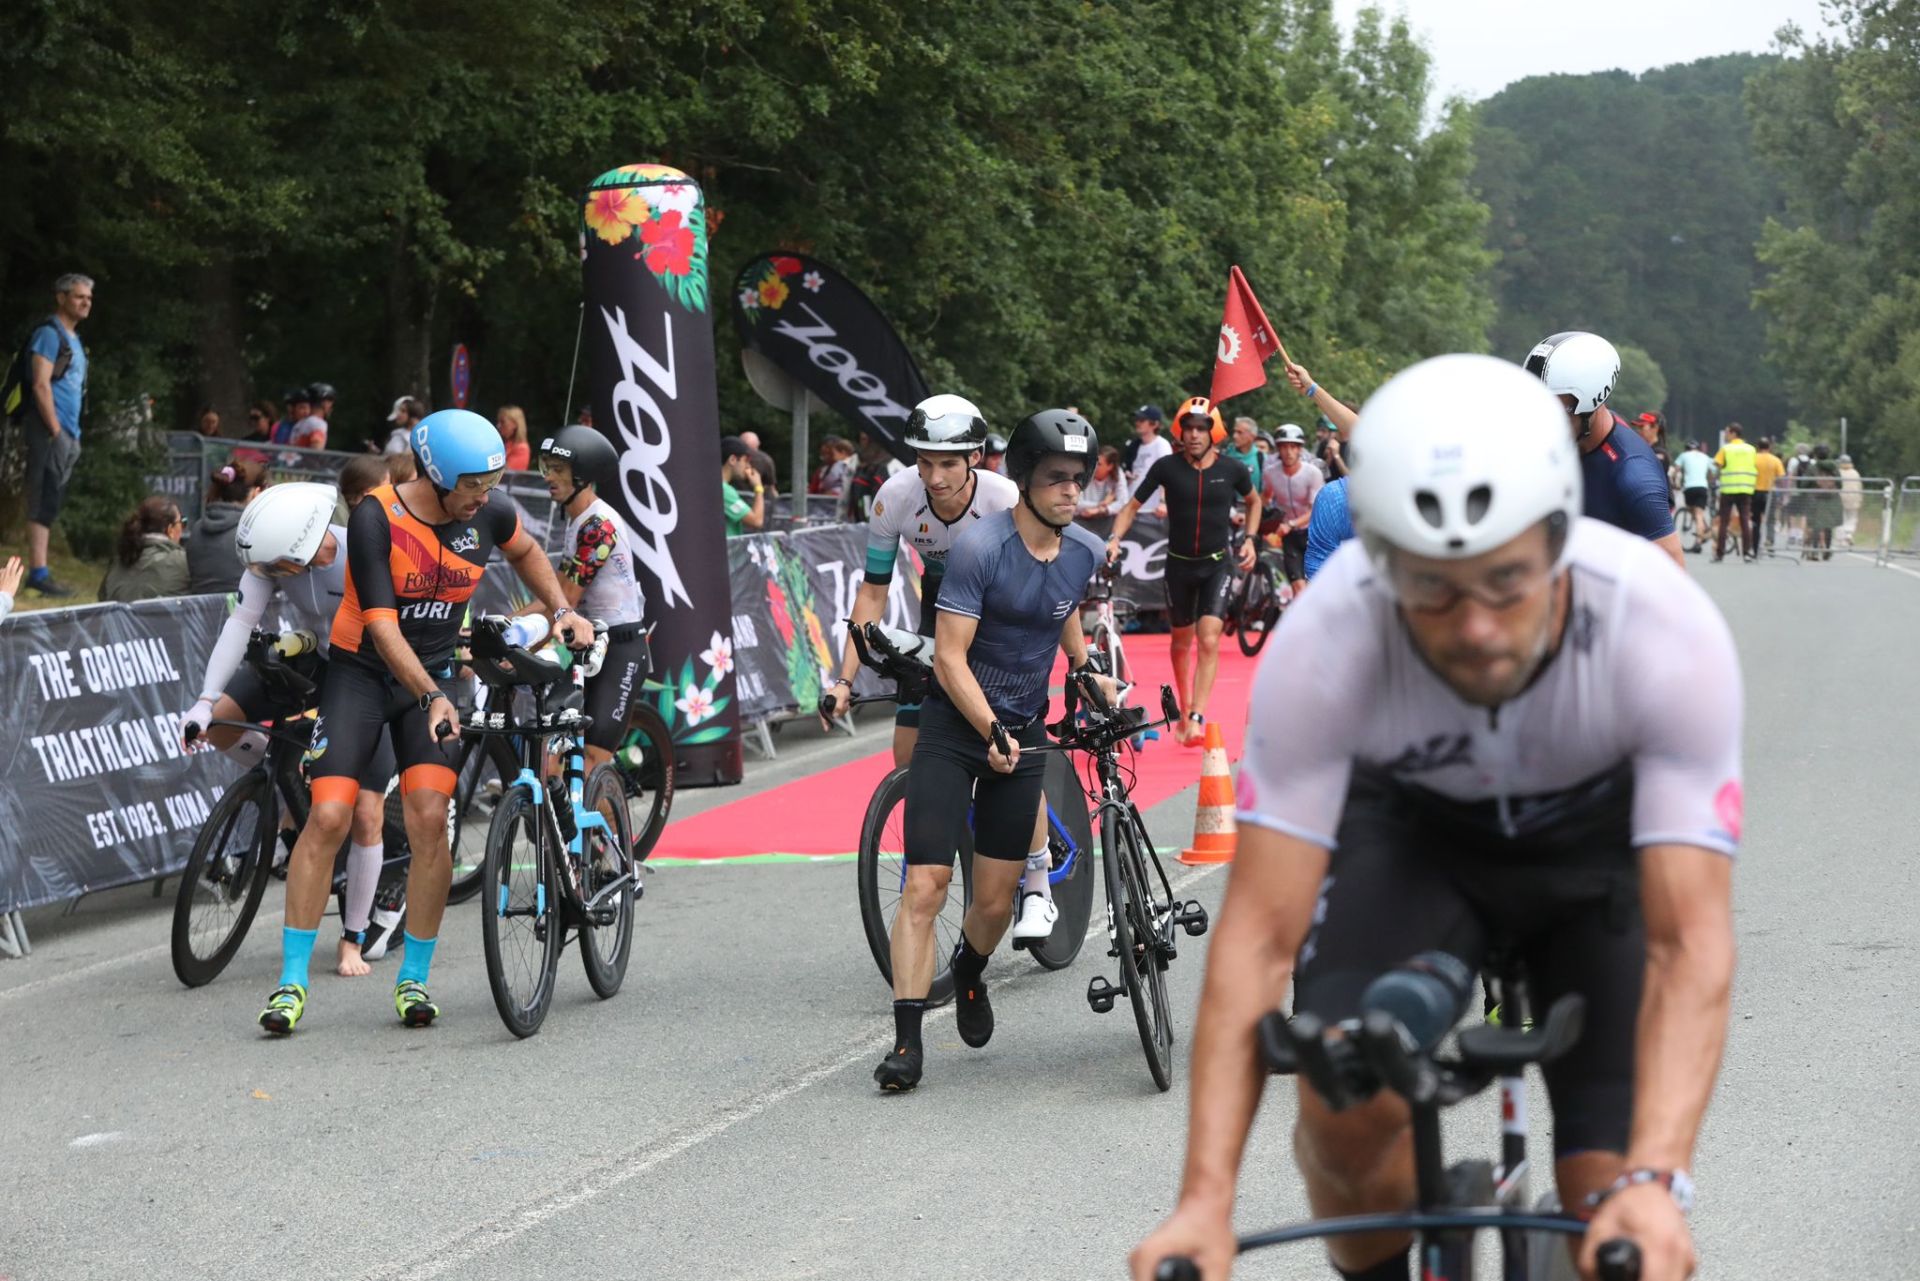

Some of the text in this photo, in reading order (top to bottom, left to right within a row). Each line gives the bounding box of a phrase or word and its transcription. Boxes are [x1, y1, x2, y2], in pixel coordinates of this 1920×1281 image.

[289, 505, 319, 554] RUDY
[400, 601, 454, 620] TURI
[29, 637, 180, 701] THE ORIGINAL
[31, 718, 159, 783] TRIATHLON
